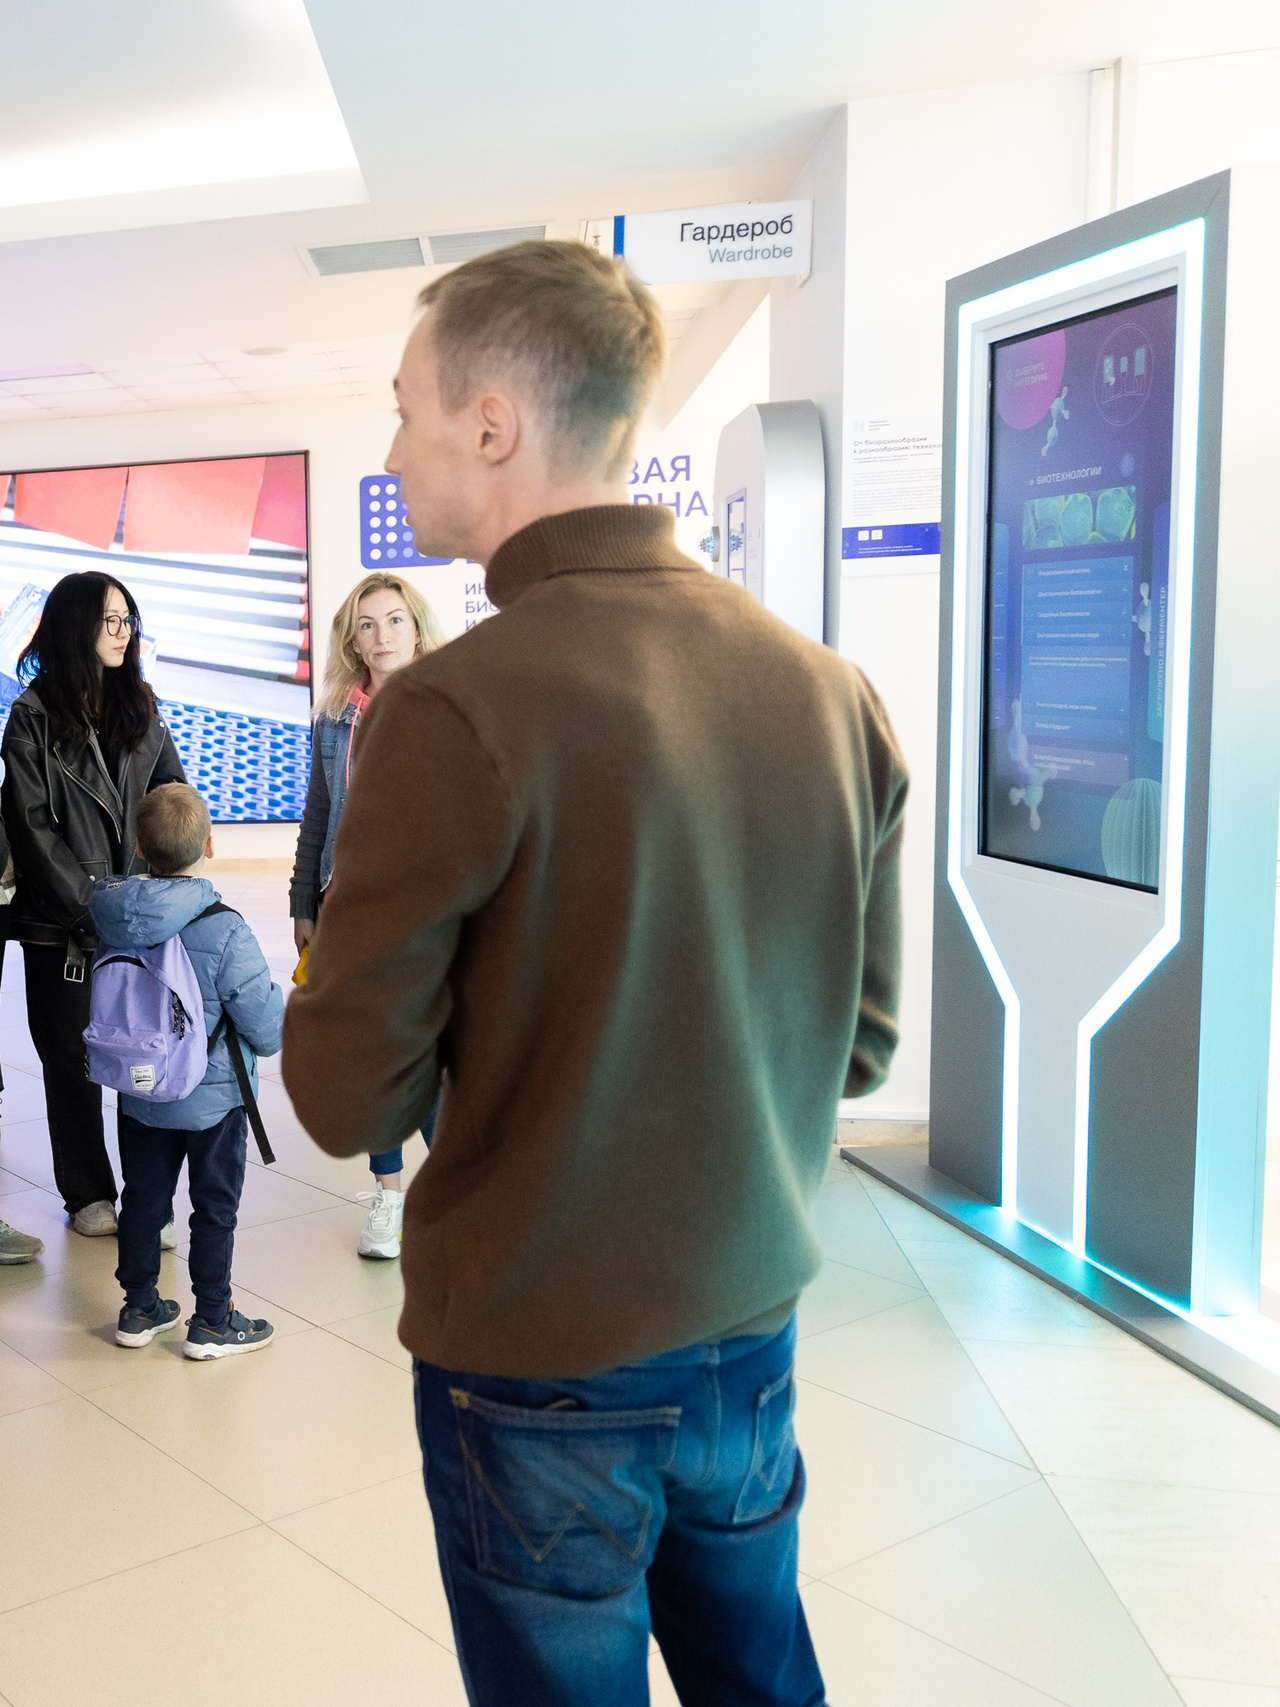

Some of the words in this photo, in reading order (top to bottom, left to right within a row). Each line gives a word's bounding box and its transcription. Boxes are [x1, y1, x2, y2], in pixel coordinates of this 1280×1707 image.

[680, 214, 793, 245] Гардероб
[708, 244, 793, 263] Wardrobe
[628, 455, 691, 485] ВАЯ
[1036, 466, 1102, 485] БИОТЕХНОЛОГИИ
[465, 583, 486, 595] ИН
